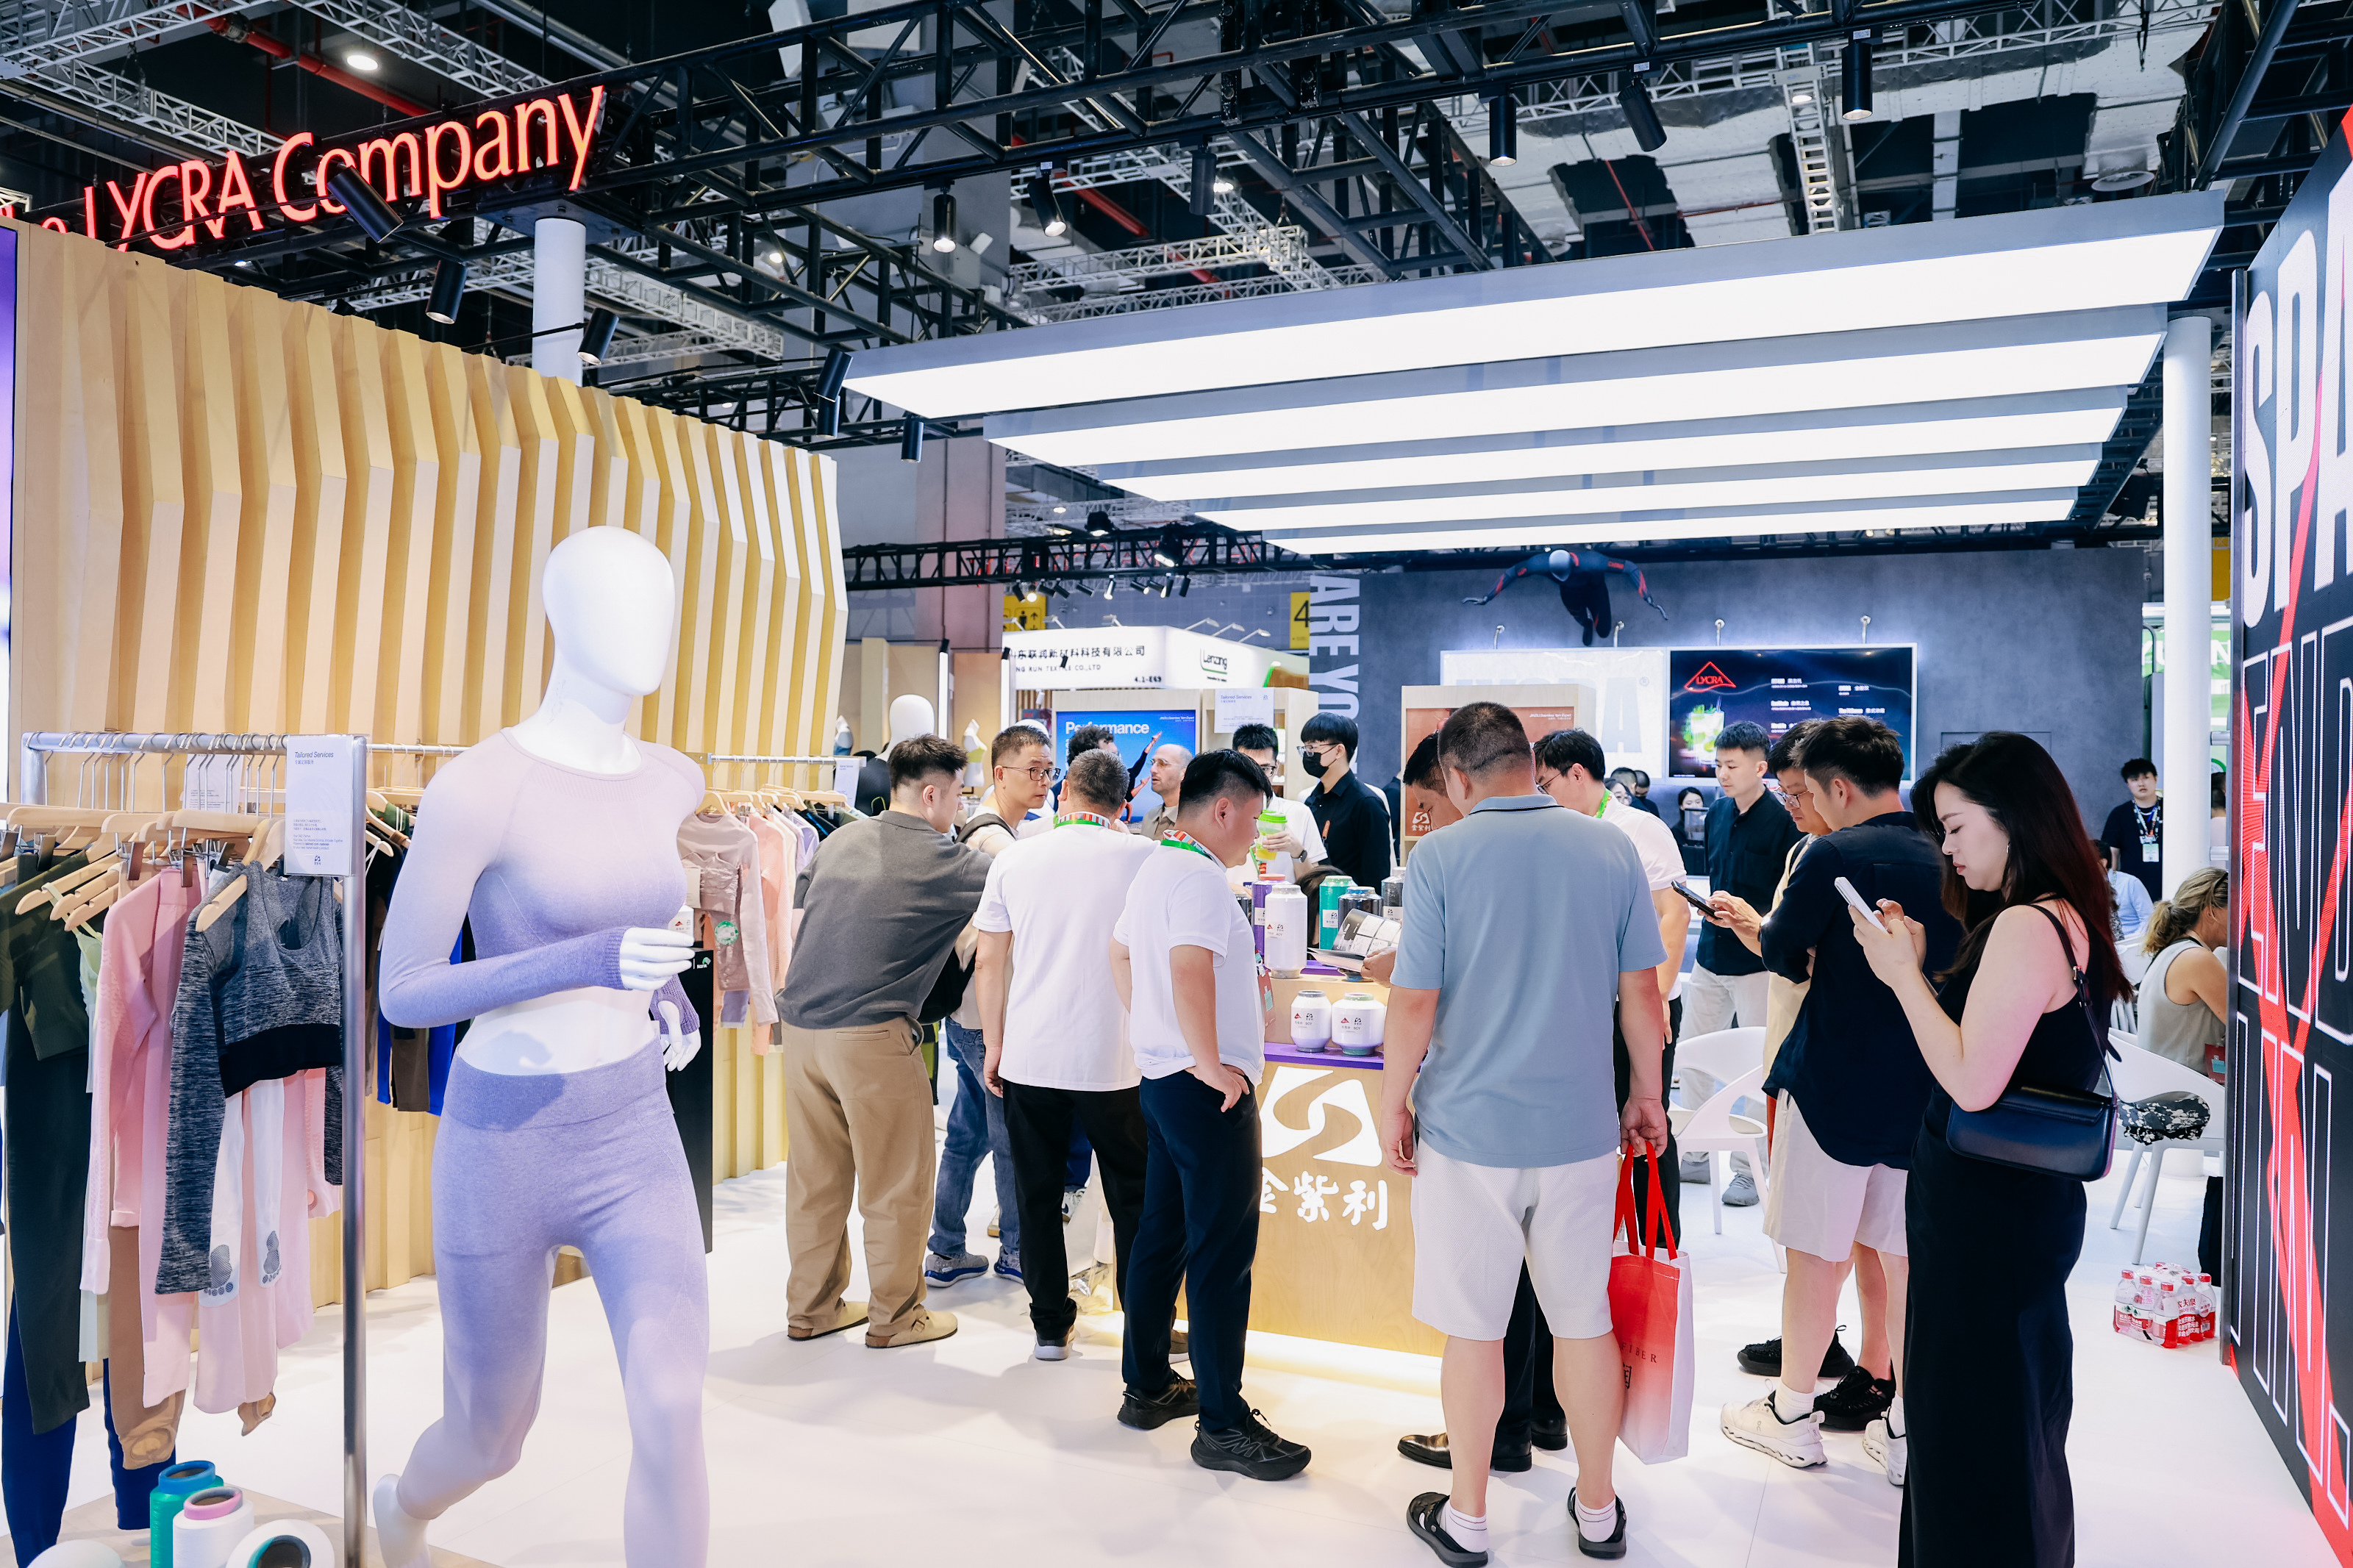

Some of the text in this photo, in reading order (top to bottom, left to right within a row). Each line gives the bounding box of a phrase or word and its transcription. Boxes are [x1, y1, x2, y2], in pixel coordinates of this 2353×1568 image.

[274, 85, 604, 221] Company
[1294, 600, 1310, 628] 4
[1010, 645, 1145, 659] 东联润新材料科技有限公司
[1203, 650, 1227, 670] Lenzing
[1309, 575, 1360, 724] ARE YO
[1696, 676, 1724, 684] LYCRA
[1621, 1342, 1657, 1363] FIBER
